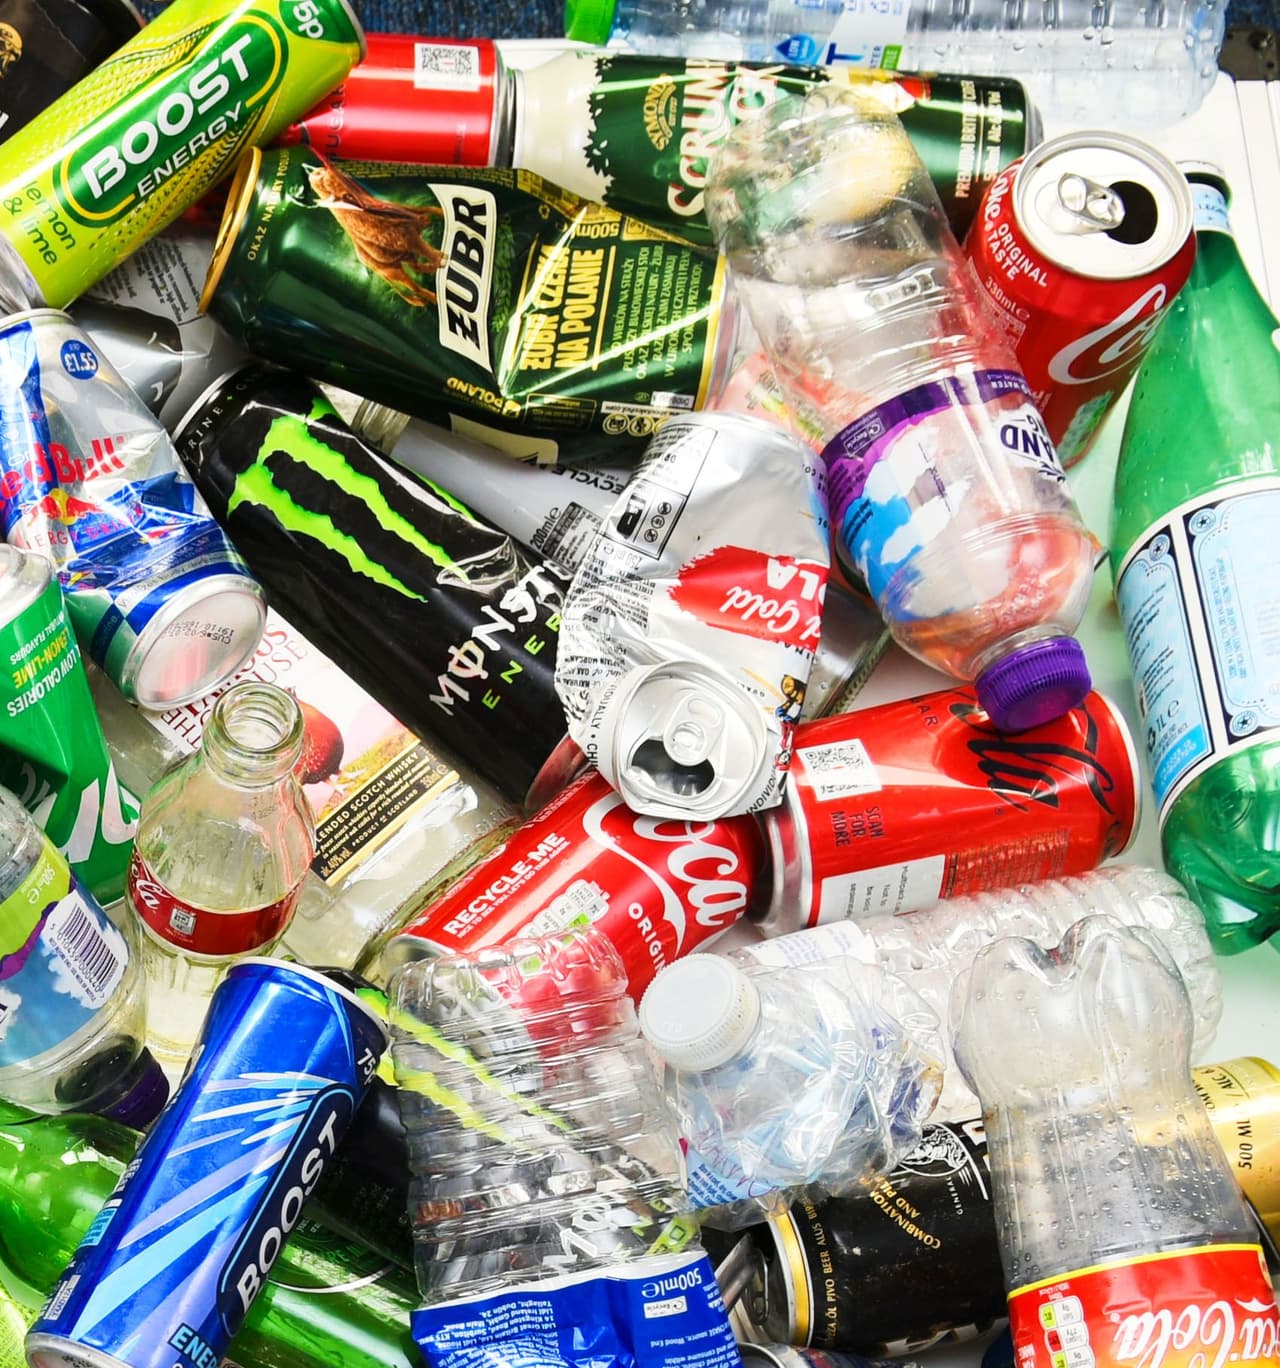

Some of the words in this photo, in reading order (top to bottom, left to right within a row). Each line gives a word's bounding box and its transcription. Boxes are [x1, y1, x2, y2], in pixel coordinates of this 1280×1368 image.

[81, 32, 254, 199] BOOST
[136, 100, 244, 201] ENERGY
[22, 182, 78, 252] lemon
[26, 224, 58, 267] lime
[987, 232, 1020, 281] TASTE
[998, 222, 1048, 288] ORIGINAL
[350, 778, 387, 810] SCOTCH
[386, 751, 420, 781] WHISKY
[235, 1111, 340, 1314] BOOST
